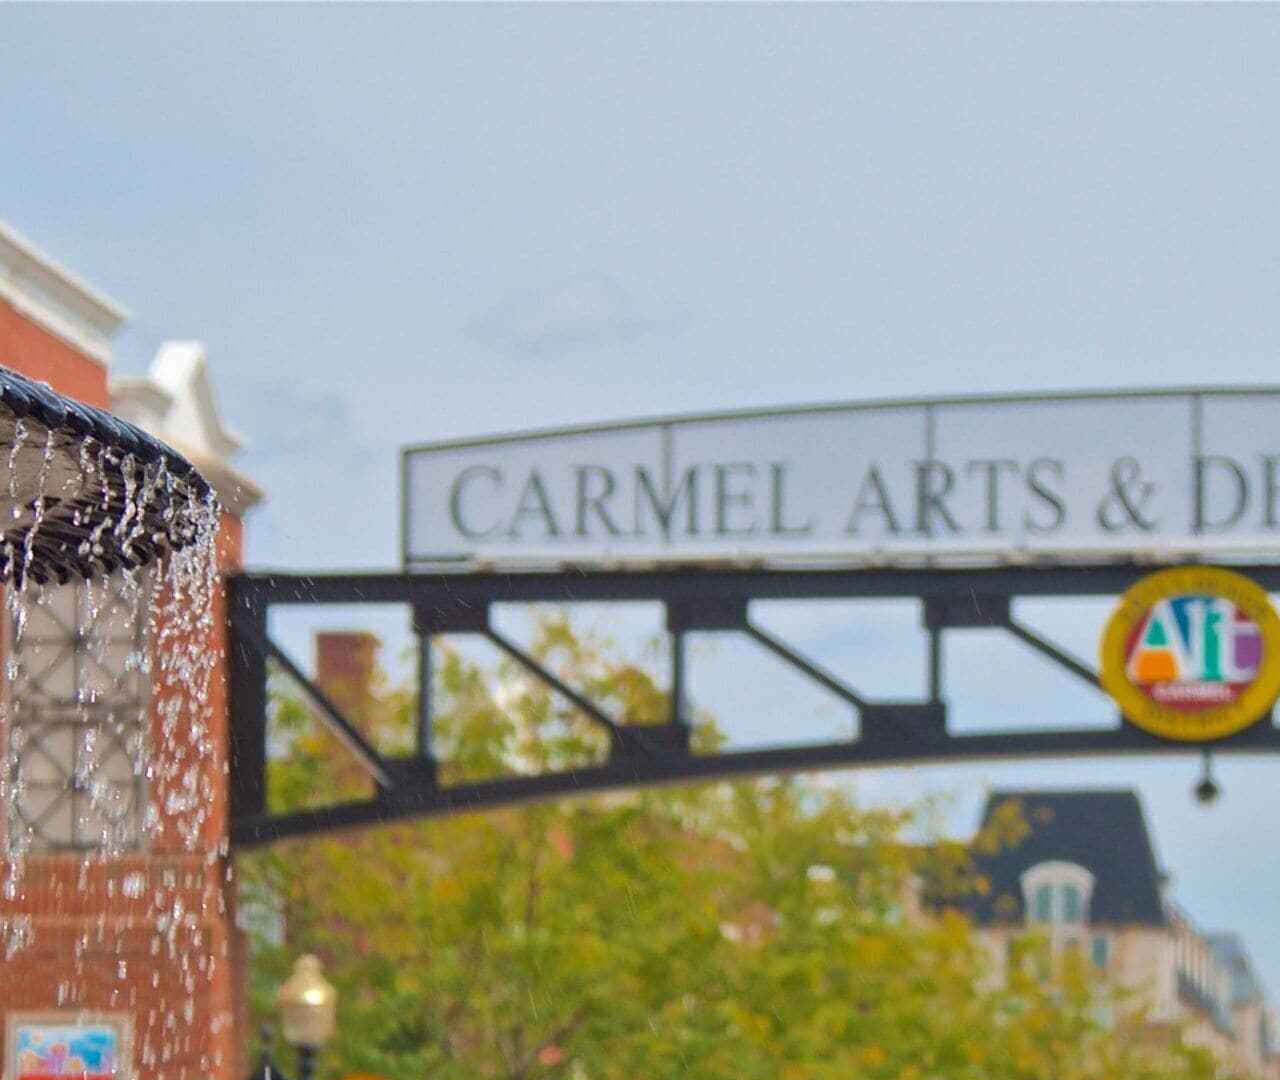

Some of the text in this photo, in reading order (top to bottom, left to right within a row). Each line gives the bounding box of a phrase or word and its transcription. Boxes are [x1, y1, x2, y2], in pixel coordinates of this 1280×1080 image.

[448, 461, 814, 541] CARMEL
[847, 456, 1067, 537] ARTS
[1096, 455, 1157, 533] &
